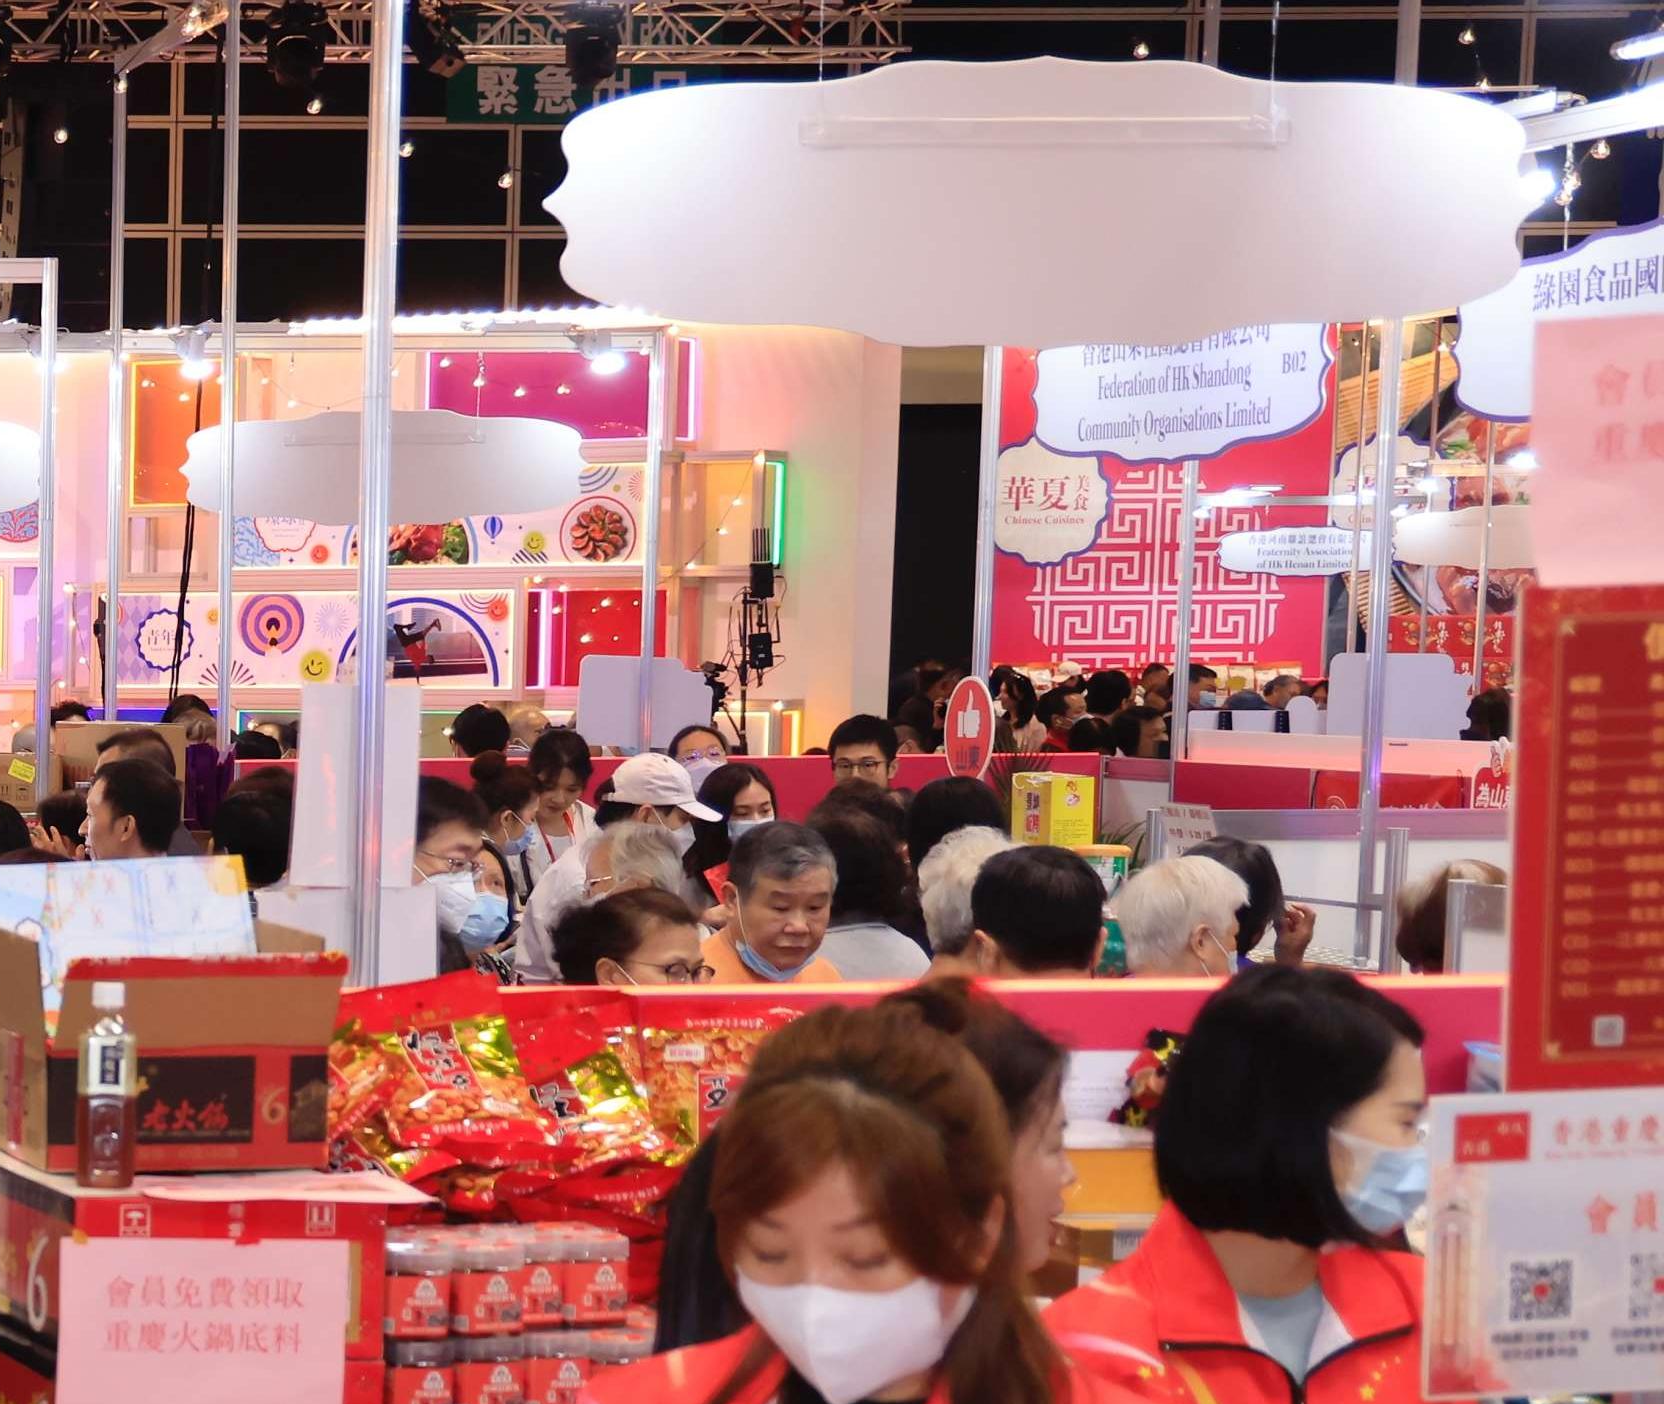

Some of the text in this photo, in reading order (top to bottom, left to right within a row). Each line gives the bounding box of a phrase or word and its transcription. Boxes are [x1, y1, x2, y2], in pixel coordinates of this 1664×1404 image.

[1532, 254, 1664, 312] 綠園食品國
[1097, 359, 1252, 401] Federation of HK Shandong
[1281, 351, 1307, 374] B02
[1077, 396, 1272, 445] Community Organisations Limited
[1001, 475, 1071, 511] 華夏
[1074, 474, 1090, 511] 美食
[1004, 514, 1086, 525] Chinese Cuisines
[1256, 559, 1267, 570] of
[1284, 560, 1315, 569] Henan
[1316, 559, 1353, 569] Limited
[1257, 547, 1301, 558] Fraternity
[260, 1086, 288, 1125] 6
[26, 1234, 51, 1333] 6
[106, 1275, 306, 1311] 會員免費領取
[103, 1320, 304, 1356] 重慶火鍋底料
